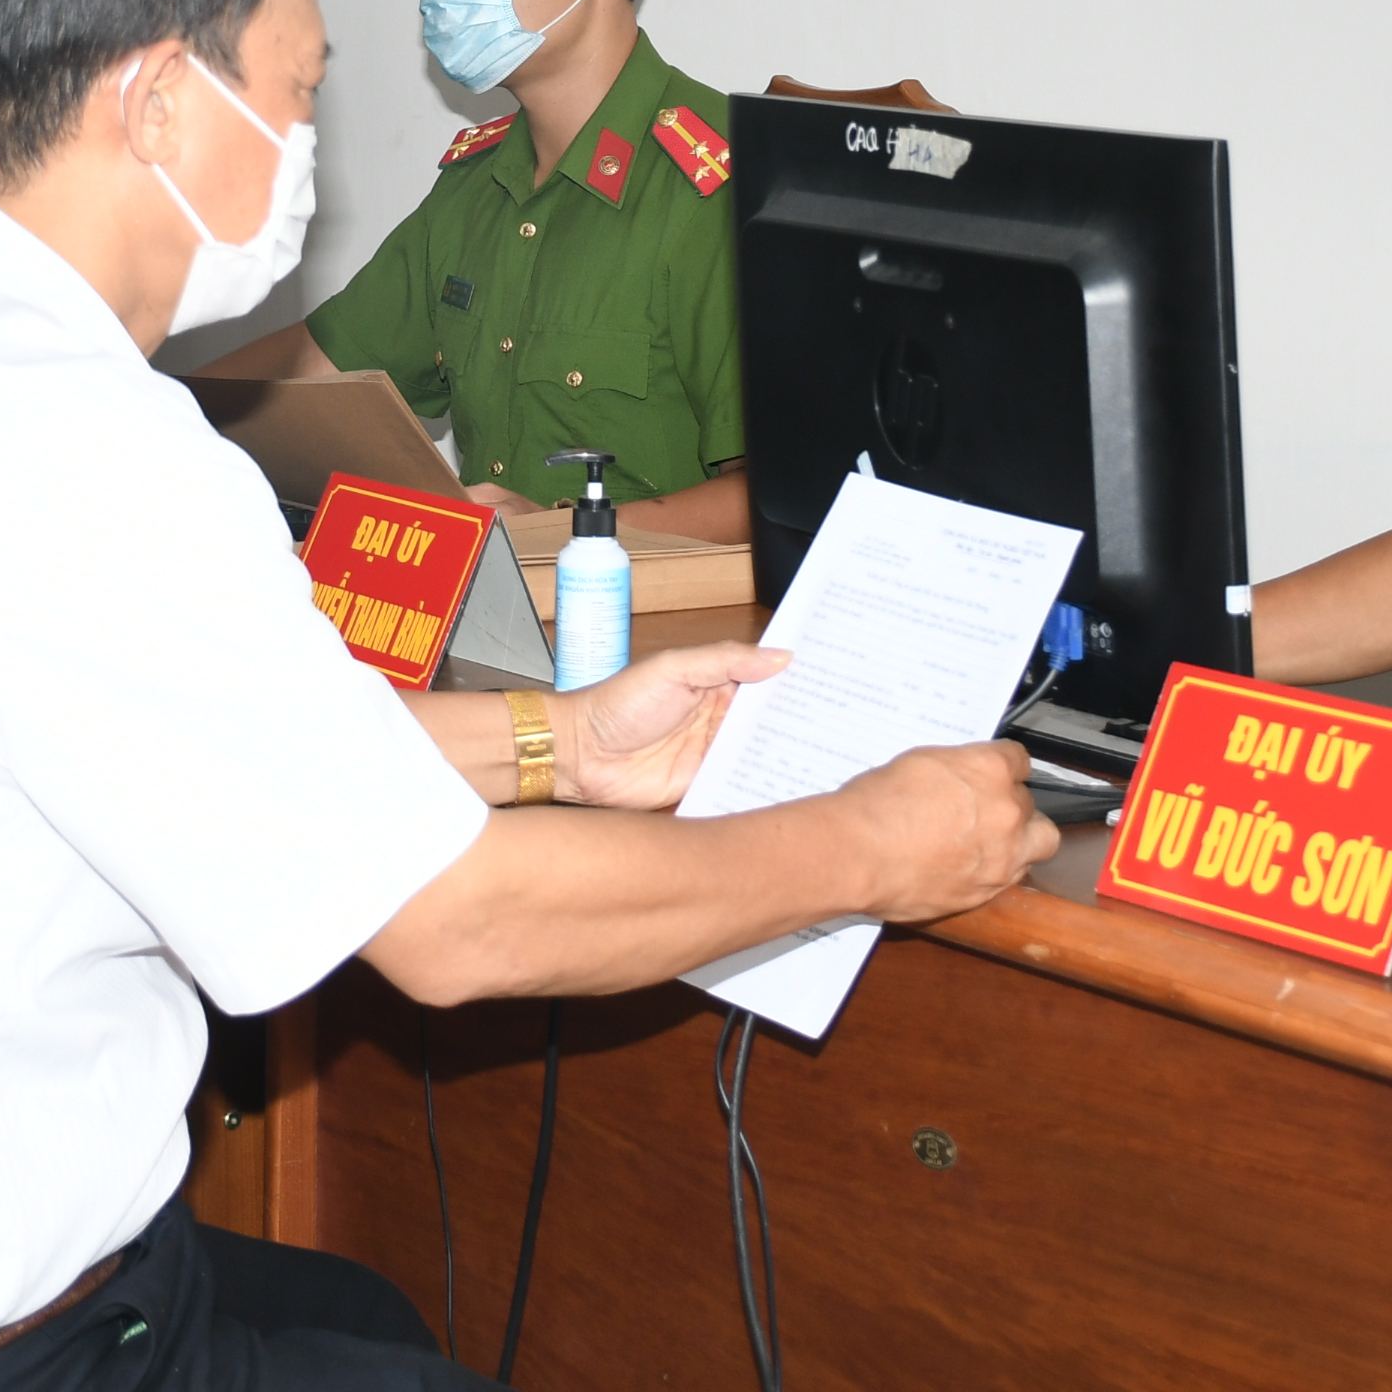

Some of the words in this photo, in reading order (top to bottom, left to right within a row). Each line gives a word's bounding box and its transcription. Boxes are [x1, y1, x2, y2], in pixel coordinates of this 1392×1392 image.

[351, 515, 399, 562] ĐẠI
[396, 520, 436, 567] ÚY
[344, 594, 403, 653] THANH
[390, 600, 442, 666] BÌNH
[1224, 714, 1303, 780] ĐẠI
[1305, 725, 1372, 790] ÚY
[1136, 783, 1205, 869] VŨ
[1193, 800, 1293, 895] ĐỨC
